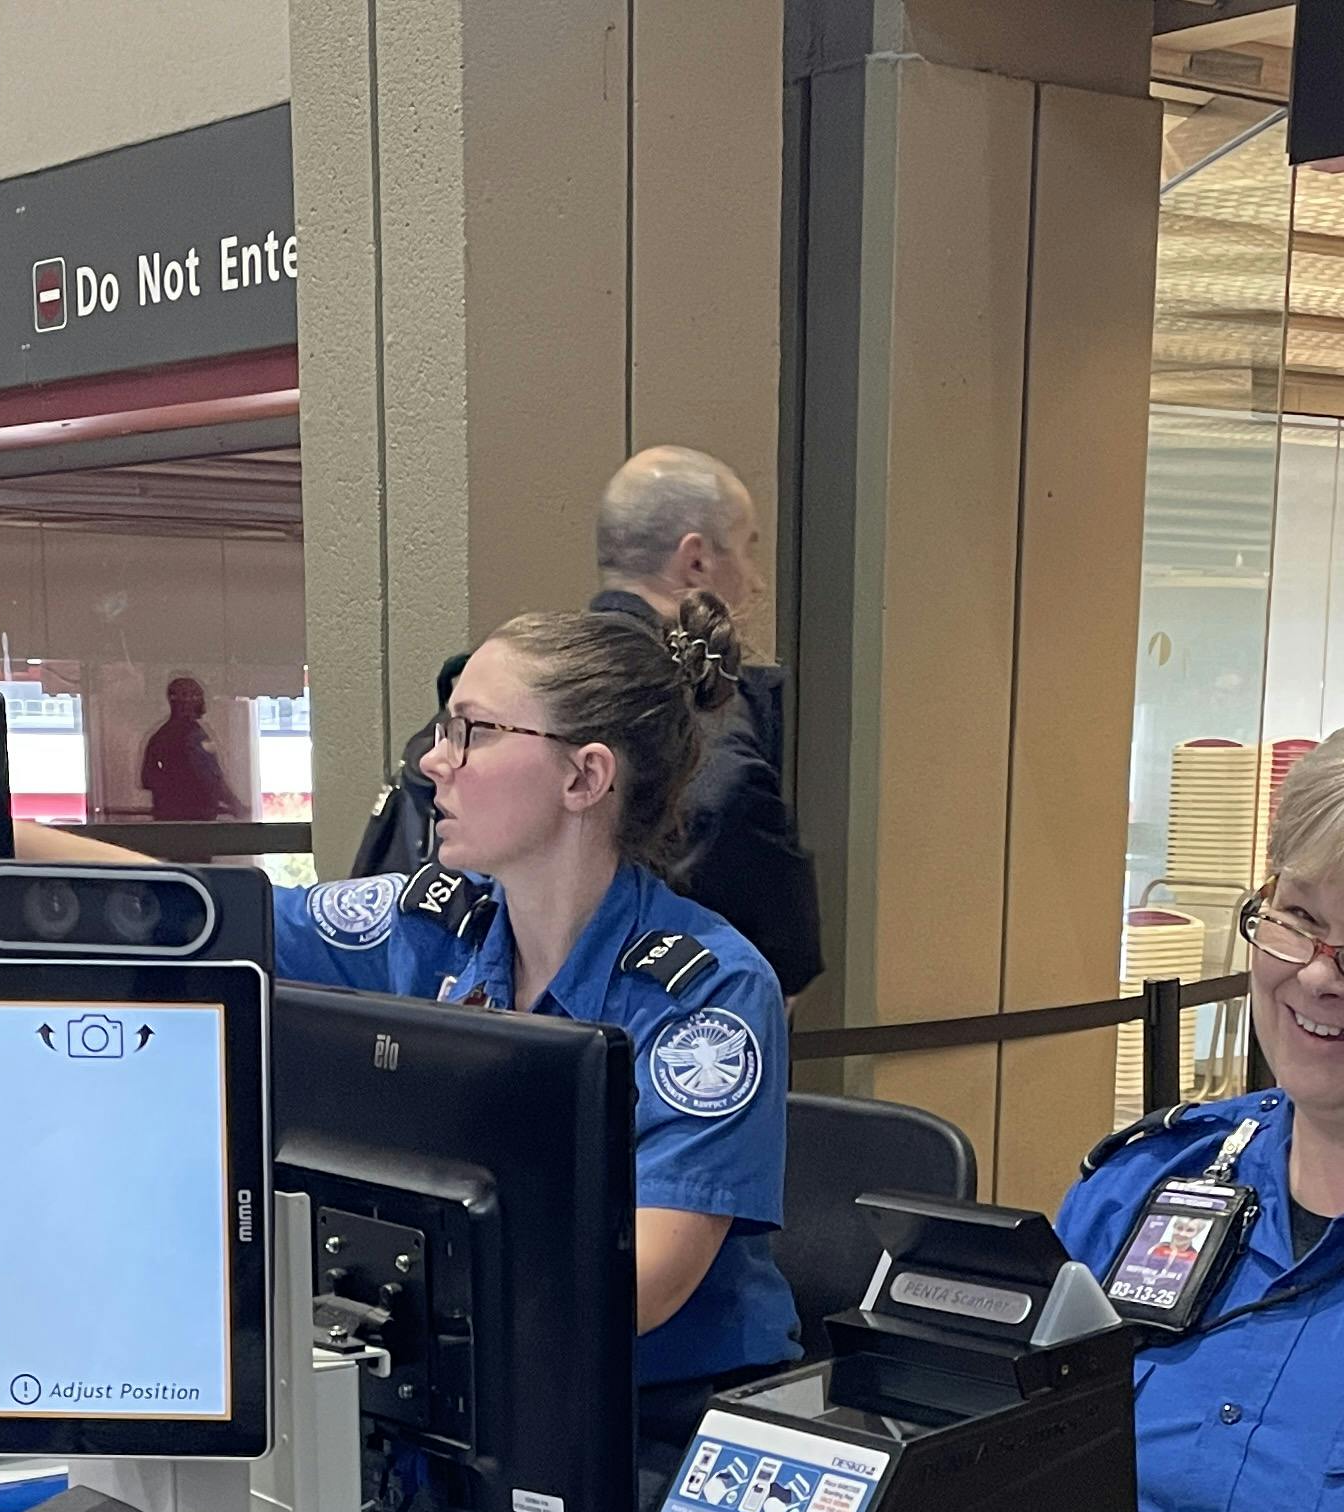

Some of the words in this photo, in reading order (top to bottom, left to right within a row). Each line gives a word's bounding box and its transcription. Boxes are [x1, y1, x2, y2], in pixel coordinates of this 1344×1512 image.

[76, 265, 119, 317] Do
[138, 247, 201, 307] Not
[418, 871, 463, 914] TSA
[1109, 1281, 1176, 1304] 03-13-25
[48, 1381, 113, 1403] Adjust
[120, 1382, 200, 1401] Position
